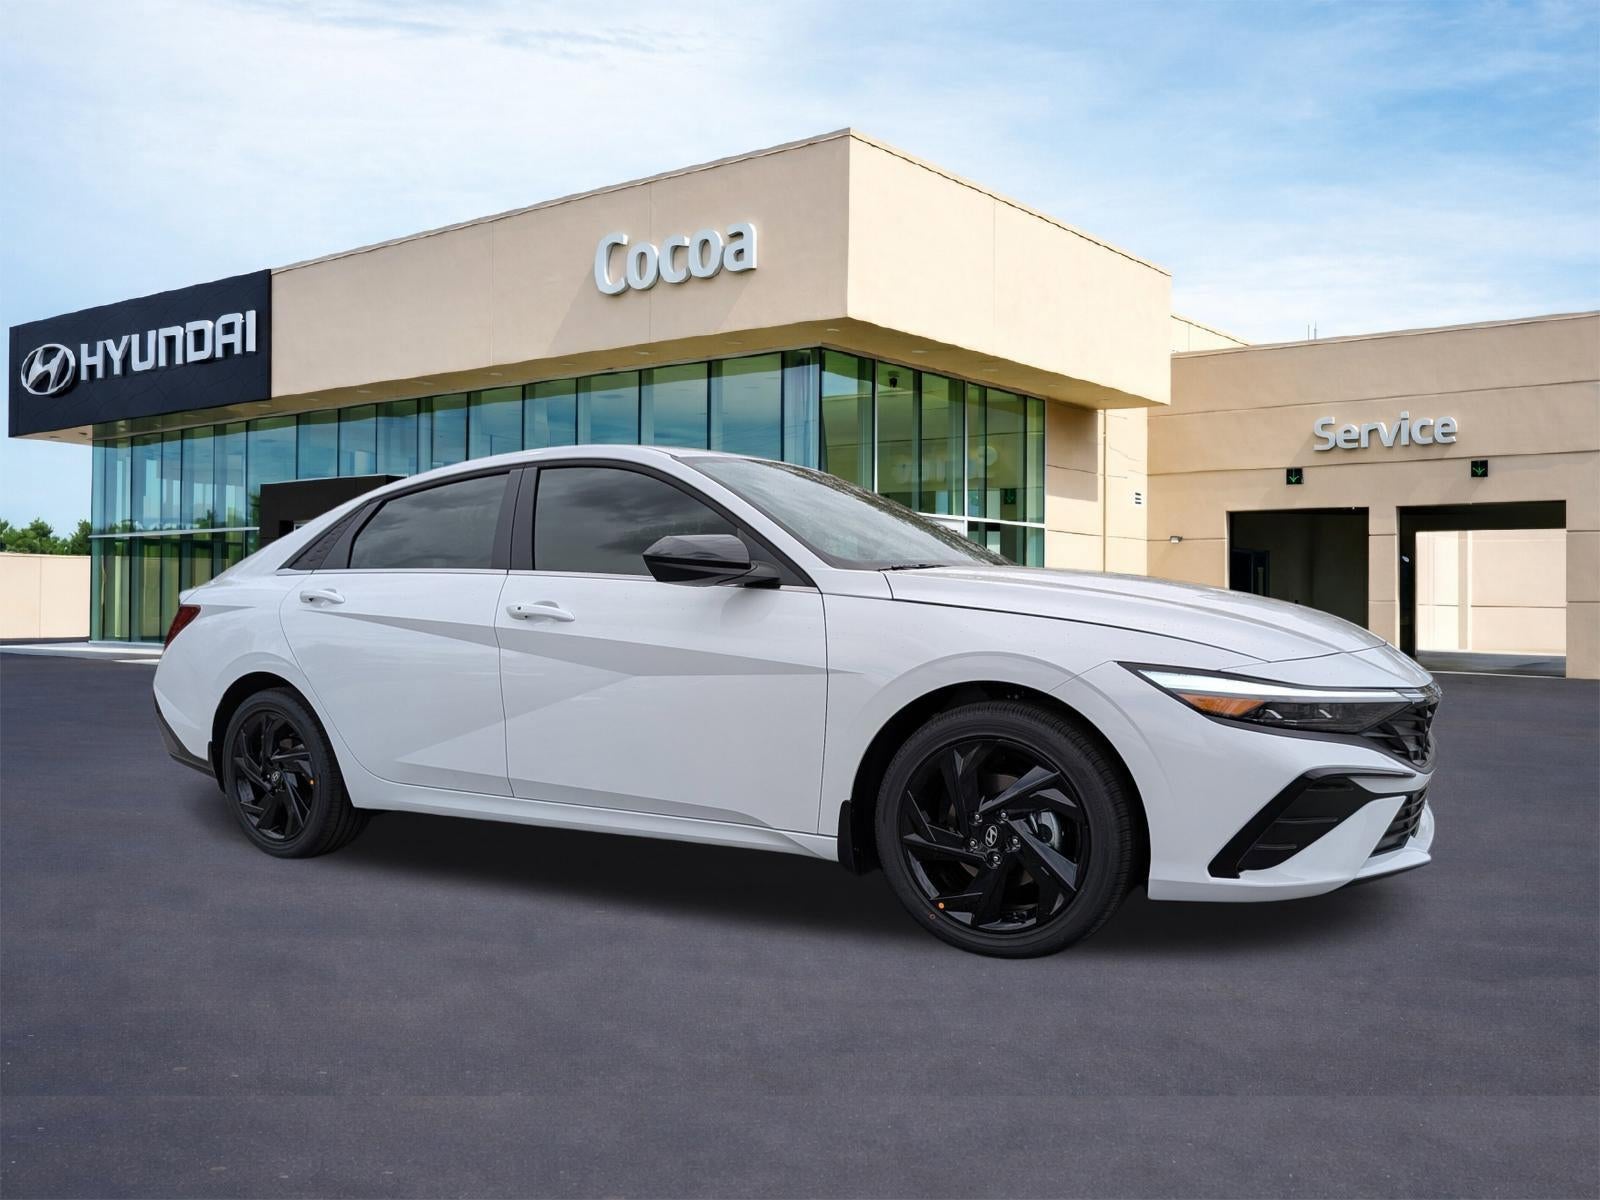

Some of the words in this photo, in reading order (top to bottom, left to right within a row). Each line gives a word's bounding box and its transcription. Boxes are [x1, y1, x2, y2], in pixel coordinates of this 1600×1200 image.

[594, 223, 757, 295] Cocoa
[80, 310, 256, 381] HYUNDAI
[1313, 411, 1458, 451] Service
